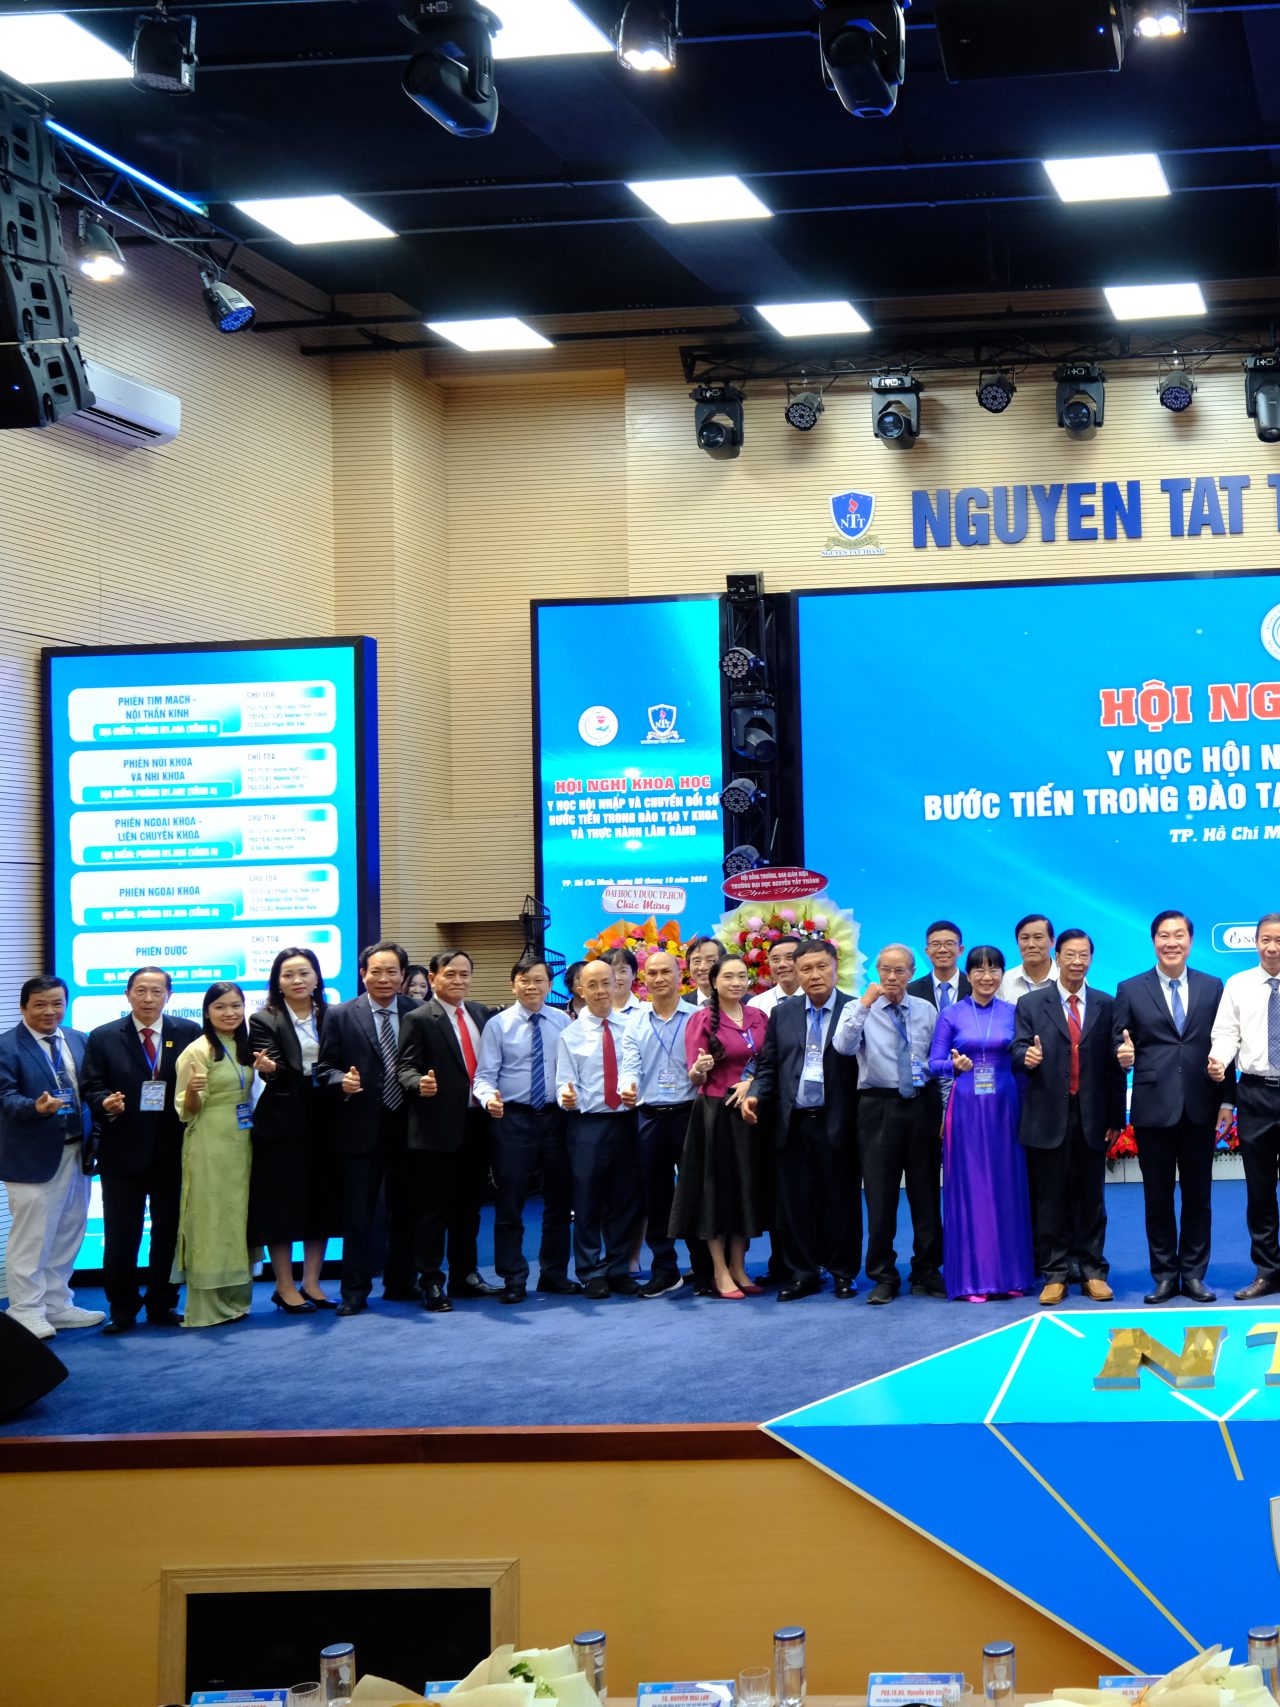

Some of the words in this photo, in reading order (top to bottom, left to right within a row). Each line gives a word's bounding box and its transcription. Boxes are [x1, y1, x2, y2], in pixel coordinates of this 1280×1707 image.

[912, 480, 1142, 547] NGUYEN
[1160, 475, 1250, 536] TAT
[840, 514, 865, 529] NTT
[147, 696, 162, 704] TIM
[1100, 679, 1192, 732] HỘI
[168, 709, 189, 717] KINH
[170, 758, 192, 766] KHOA
[1107, 750, 1125, 776] Y
[1134, 747, 1192, 780] HỌC
[1202, 740, 1250, 778] HỘI
[145, 772, 159, 781] NHI
[163, 772, 185, 780] KHOA
[555, 779, 582, 795] HỘI
[587, 778, 626, 794] NGHỊ
[632, 777, 675, 790] KHOA
[680, 775, 711, 792] HỌC
[547, 801, 554, 811] Y
[579, 797, 595, 812] HỘI
[628, 795, 641, 808] VÀ
[924, 785, 1000, 821] BƯỚC
[1010, 782, 1074, 817] TIẾN
[1083, 785, 1179, 815] TRONG
[1188, 779, 1247, 811] ĐÀO
[173, 817, 196, 826] KHOA
[603, 812, 635, 824] TRONG
[661, 811, 680, 824] TẠO
[683, 811, 689, 821] Y
[692, 810, 718, 820] KHOA
[176, 831, 199, 839] KHOA
[571, 827, 584, 839] VÀ
[615, 826, 642, 838] HÀNH
[645, 824, 666, 836] LÂM
[669, 824, 696, 836] SÀNG
[1169, 828, 1198, 844] TP.
[1203, 825, 1226, 842] Hồ
[1231, 824, 1259, 841] Chí
[178, 886, 200, 895] KHOA
[633, 890, 638, 898] Y
[659, 891, 683, 899] TP.HCM
[616, 900, 639, 909] Chúc
